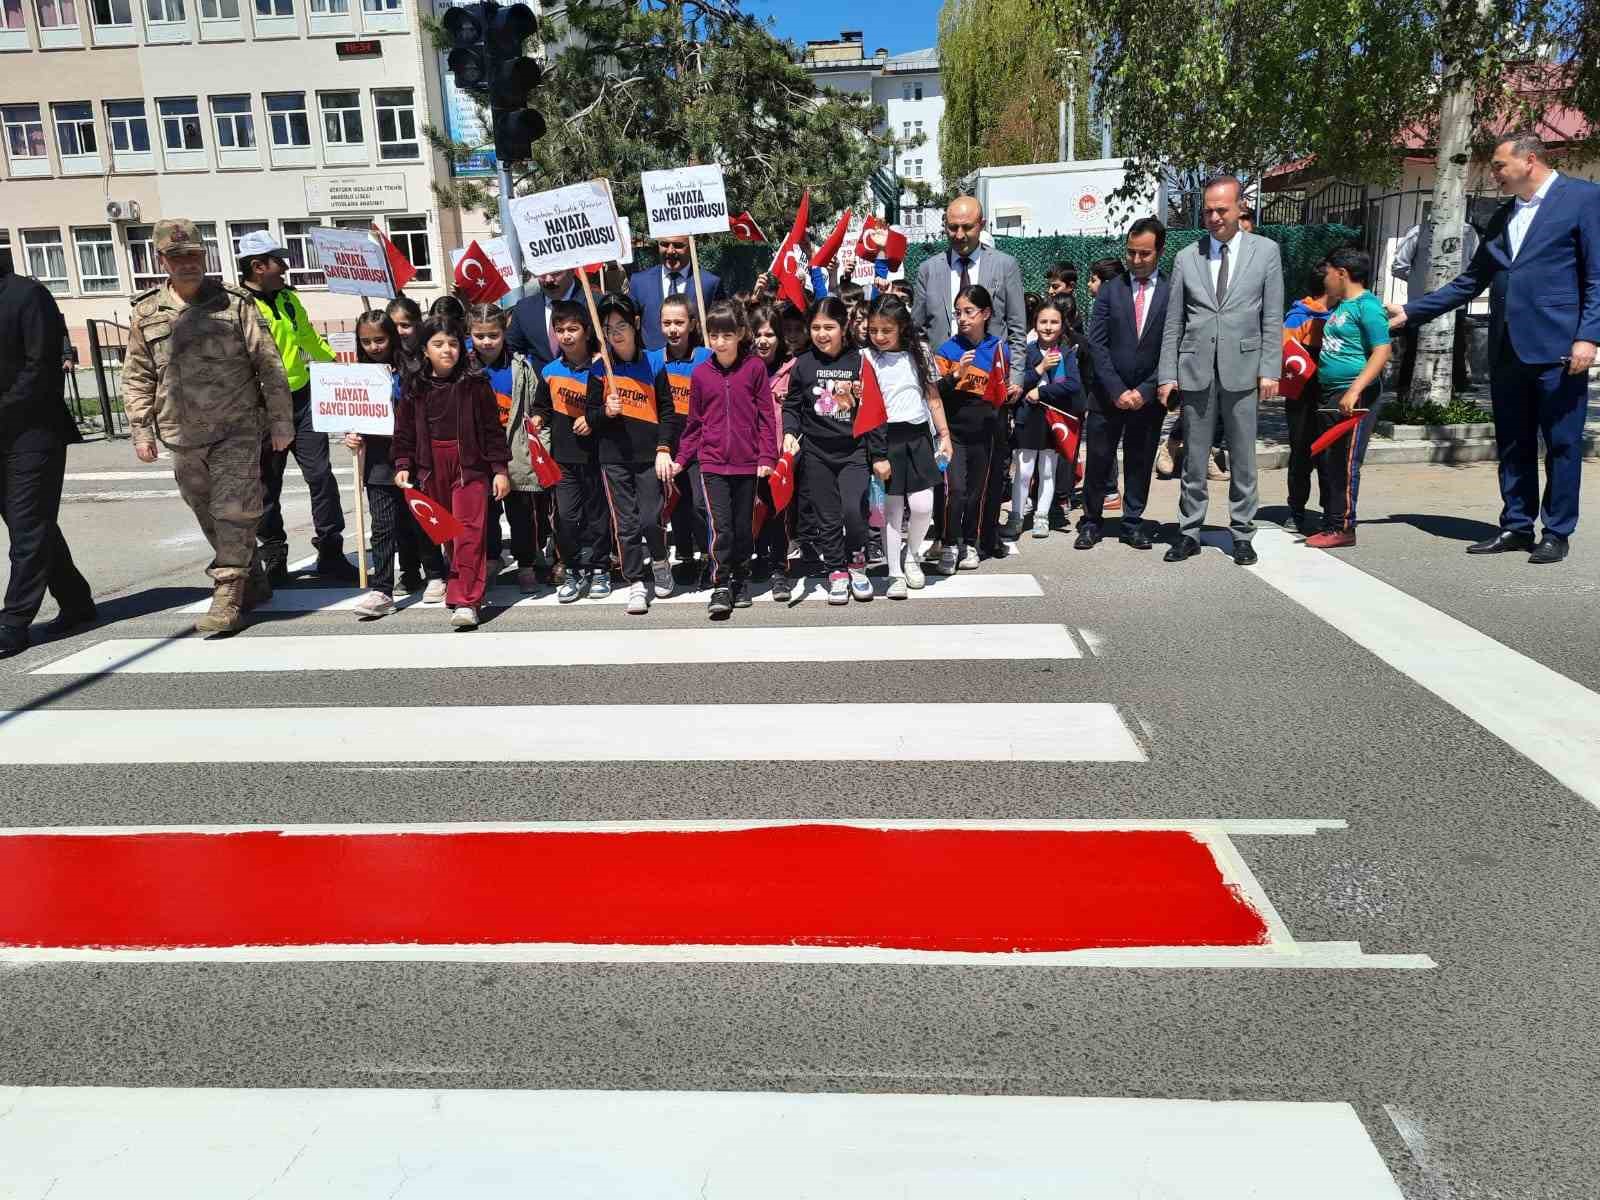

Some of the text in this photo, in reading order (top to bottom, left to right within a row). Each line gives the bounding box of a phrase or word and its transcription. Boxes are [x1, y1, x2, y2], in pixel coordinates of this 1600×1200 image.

[667, 190, 704, 206] HAYATA
[652, 202, 725, 222] SAYGI DURUŞU
[544, 212, 591, 236] HAYATA
[529, 226, 615, 258] SAYGI DURUŞU
[335, 252, 368, 267] HAYATA
[324, 265, 388, 283] SAYGI DURUŞU
[816, 369, 852, 379] FRIENDSHIP
[335, 388, 369, 402] HAYATA
[320, 401, 388, 418] SAYGI DURUŞU
